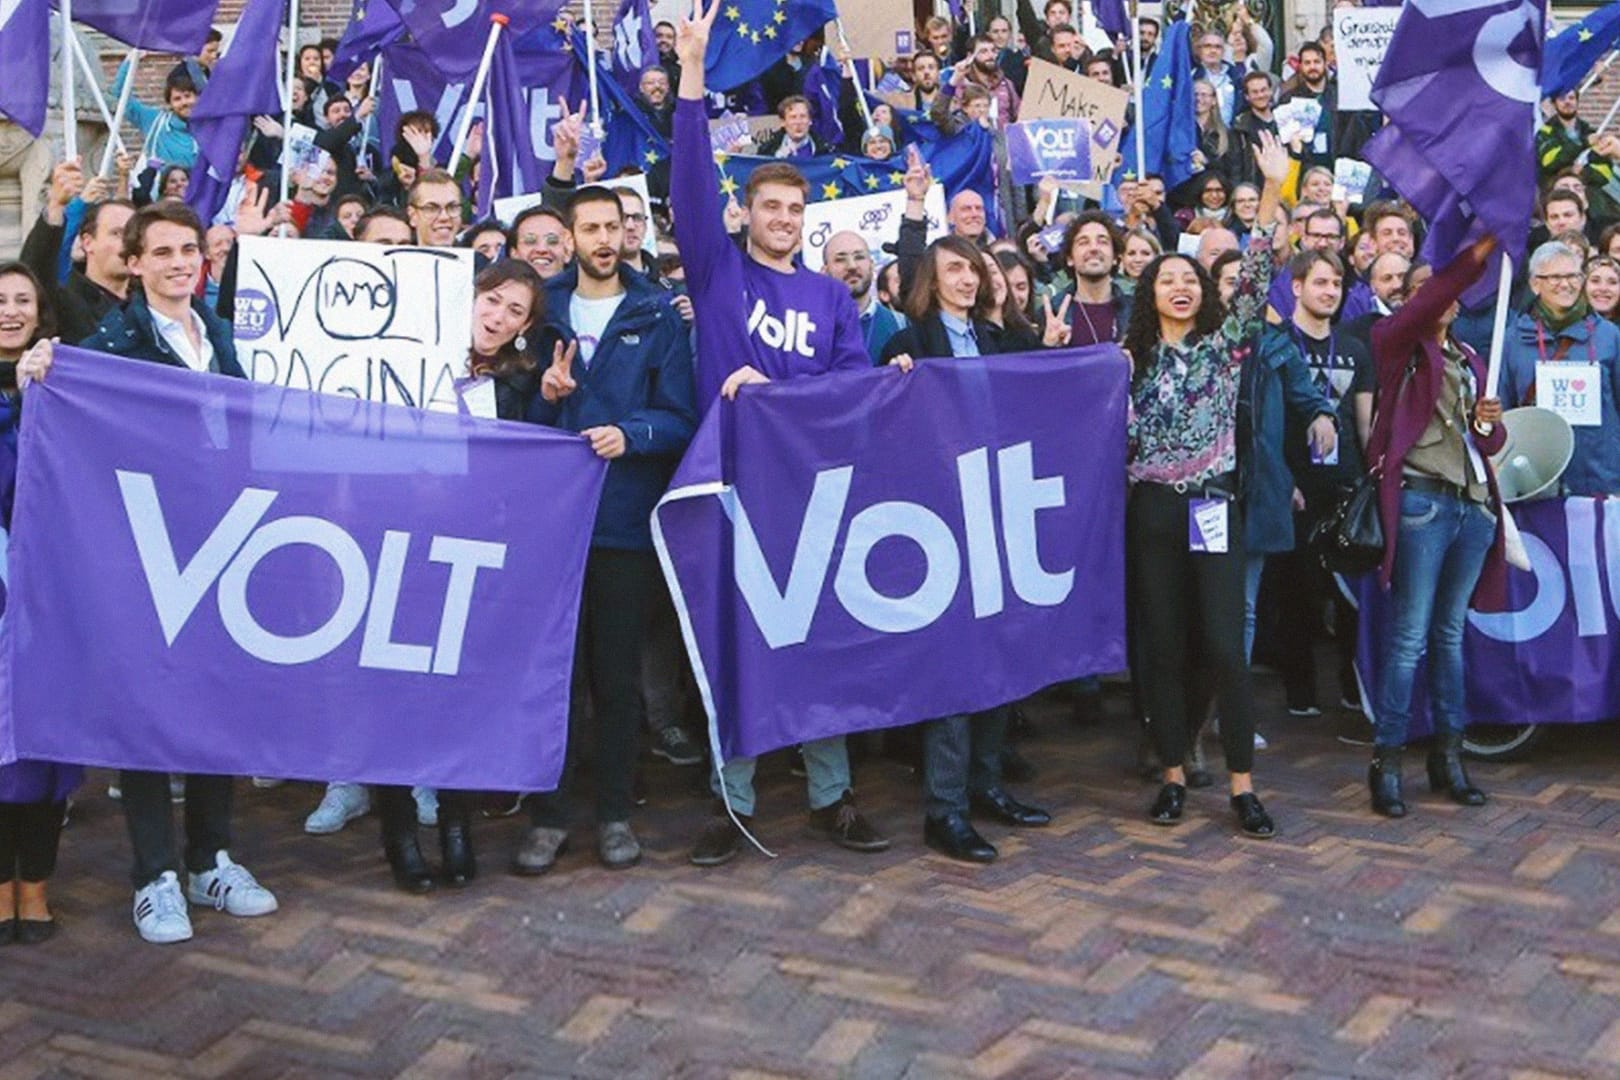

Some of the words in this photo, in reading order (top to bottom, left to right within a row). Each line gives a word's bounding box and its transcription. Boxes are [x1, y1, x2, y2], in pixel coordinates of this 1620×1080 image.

[392, 78, 561, 161] Vt
[1023, 126, 1075, 150] VOLT
[234, 311, 265, 326] EU
[252, 249, 459, 345] VOLT
[251, 348, 458, 440] PAGINA
[1552, 379, 1569, 391] W
[1553, 394, 1585, 408] EU
[115, 469, 507, 675] VOLT
[716, 441, 1075, 649] Volt
